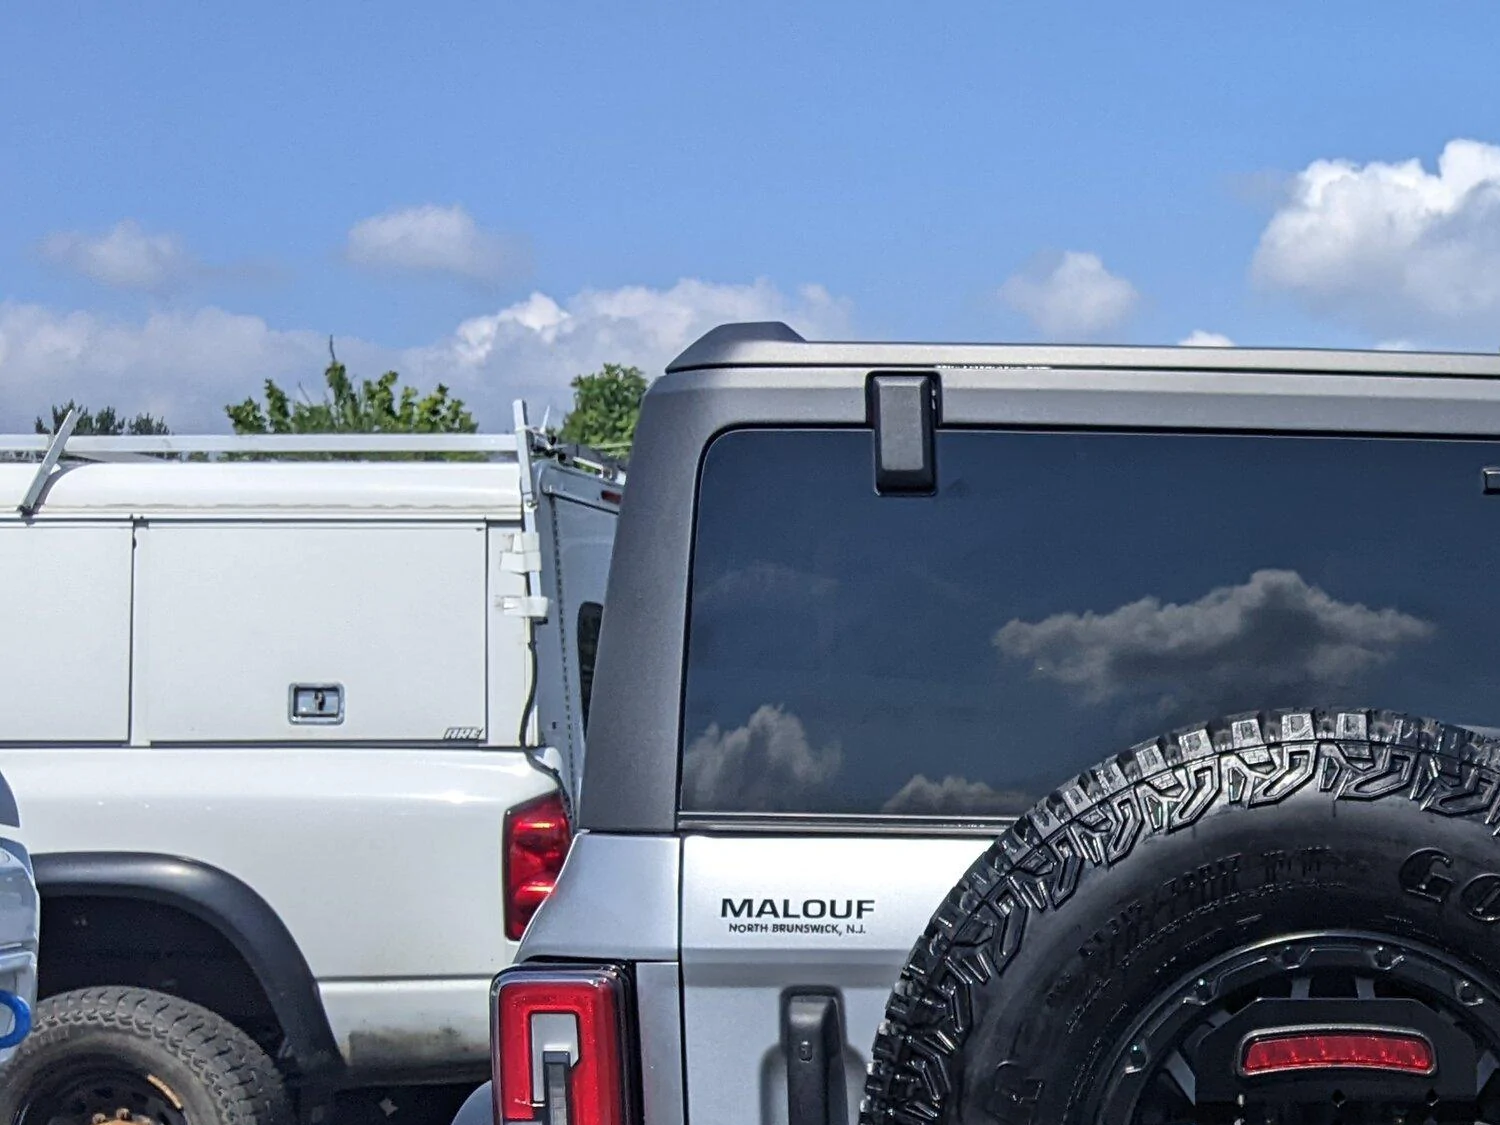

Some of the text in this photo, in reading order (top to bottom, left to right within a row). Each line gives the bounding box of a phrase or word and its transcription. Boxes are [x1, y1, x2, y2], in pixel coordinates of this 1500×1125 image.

[721, 898, 875, 919] MALOUF
[729, 923, 866, 936] NORTH BRUNSWICK, N.J.
